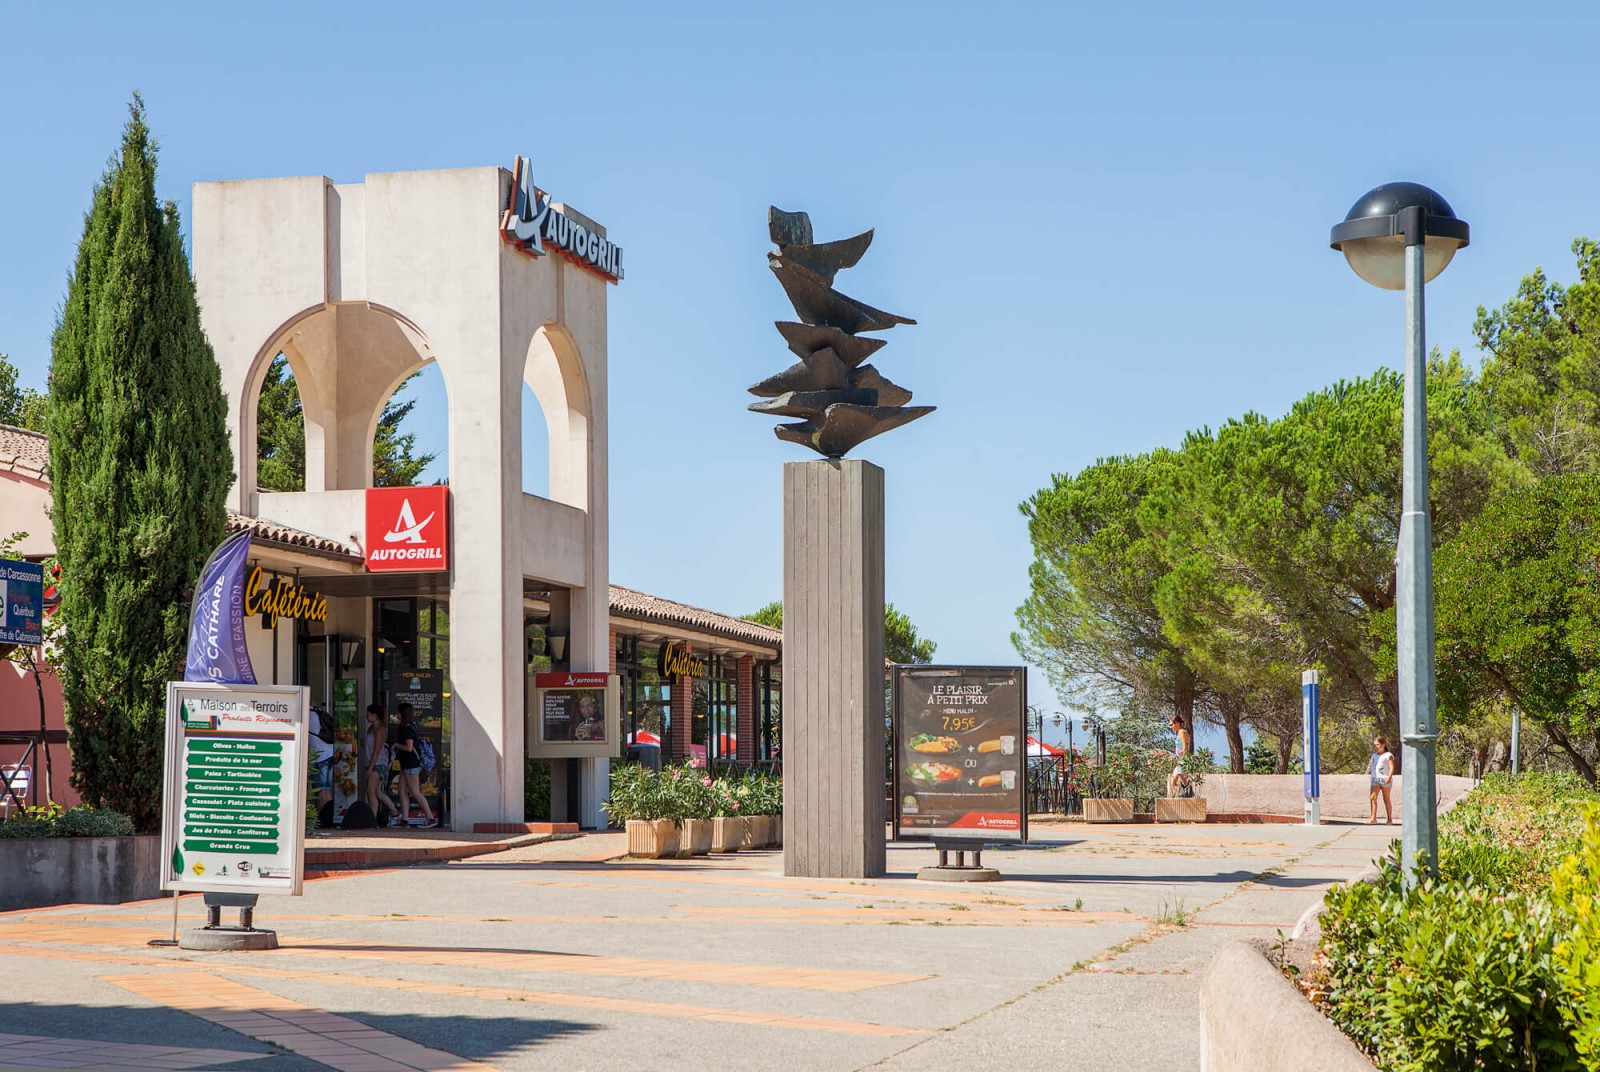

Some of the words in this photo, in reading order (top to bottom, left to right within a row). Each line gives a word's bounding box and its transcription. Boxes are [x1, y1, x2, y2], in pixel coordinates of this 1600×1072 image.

[546, 208, 624, 280] AUTOGRILL
[370, 548, 442, 560] AUTOGRILL
[8, 568, 41, 583] Carcassonne
[245, 566, 328, 629] Cafétéria
[13, 604, 34, 617] Quéribus
[207, 576, 225, 659] CATHARE
[232, 585, 244, 640] PASSION
[8, 630, 14, 640] de
[15, 630, 40, 643] Cabrespine
[664, 641, 703, 685] Cafétéria
[933, 686, 944, 694] LE
[946, 686, 983, 694] PLAISIR
[200, 699, 237, 711] Maison
[251, 700, 288, 713] Terroirs
[927, 694, 934, 704] À
[937, 696, 962, 704] PETIT
[966, 696, 988, 704] PRIX
[222, 713, 252, 722] Produits
[942, 716, 976, 731] 7,95€
[965, 759, 976, 768] OU
